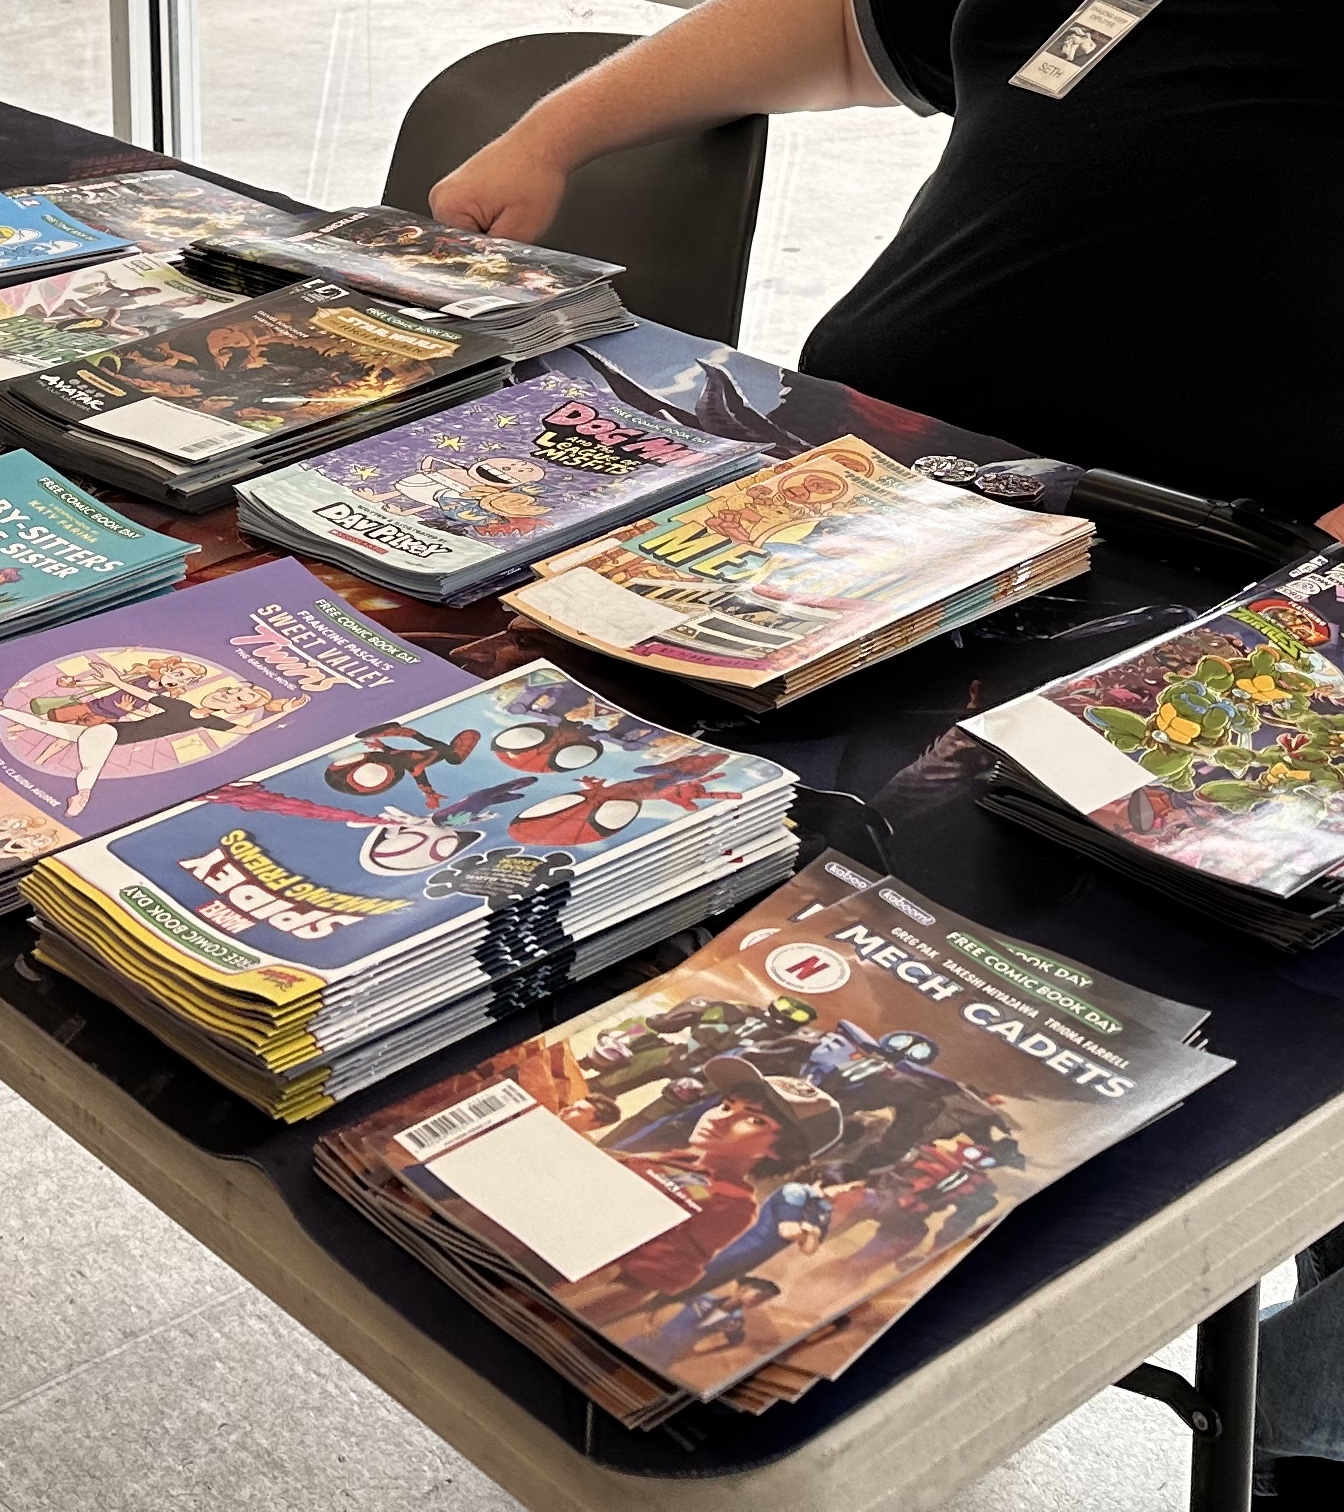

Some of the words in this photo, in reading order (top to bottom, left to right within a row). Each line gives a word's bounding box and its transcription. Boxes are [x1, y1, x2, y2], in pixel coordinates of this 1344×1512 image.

[337, 315, 390, 337] STAR
[389, 332, 443, 350] WARS
[39, 373, 105, 412] AVATAR
[543, 400, 647, 446] DOG
[28, 500, 59, 520] KATY
[57, 519, 99, 544] FARINA
[38, 477, 63, 495] FREE
[60, 493, 95, 516] COMIC
[91, 513, 120, 532] BOOK
[119, 528, 145, 540] DAY
[312, 501, 384, 532] DAV
[0, 543, 80, 580] SISTER
[257, 603, 326, 649] SWEET
[316, 647, 395, 688] VALLEY
[297, 609, 349, 646] FRANCINE
[344, 642, 394, 671] PASCAL'S
[315, 598, 341, 618] FREE
[337, 615, 373, 641] COMIC
[368, 636, 398, 656] BOOK
[395, 651, 422, 664] DAY
[229, 624, 350, 692] Twins
[235, 647, 250, 660] THE
[248, 656, 276, 678] GRAPHIC
[221, 828, 304, 891] FRIENDS
[829, 862, 868, 890] kaboo
[122, 885, 151, 907] DAY
[178, 847, 366, 940] SPIDEY
[880, 889, 933, 925] kaboom!
[149, 903, 183, 936] BOOK
[182, 925, 228, 961] COMIC
[785, 955, 830, 980] N
[946, 931, 982, 958] FREE
[984, 954, 1039, 989] COMIC
[1035, 984, 1086, 1017] BOOK
[1084, 1011, 1123, 1035] DAY
[1053, 967, 1094, 988] DAY
[835, 924, 961, 1002] MECH
[962, 1002, 1136, 1099] CADETS
[890, 926, 919, 950] GREG
[916, 942, 940, 960] PAK
[942, 958, 987, 993] TAKESHI
[983, 983, 1040, 1019] MIYAZAWA
[1044, 1017, 1085, 1049] TRIONA
[1081, 1038, 1130, 1069] FARRELL
